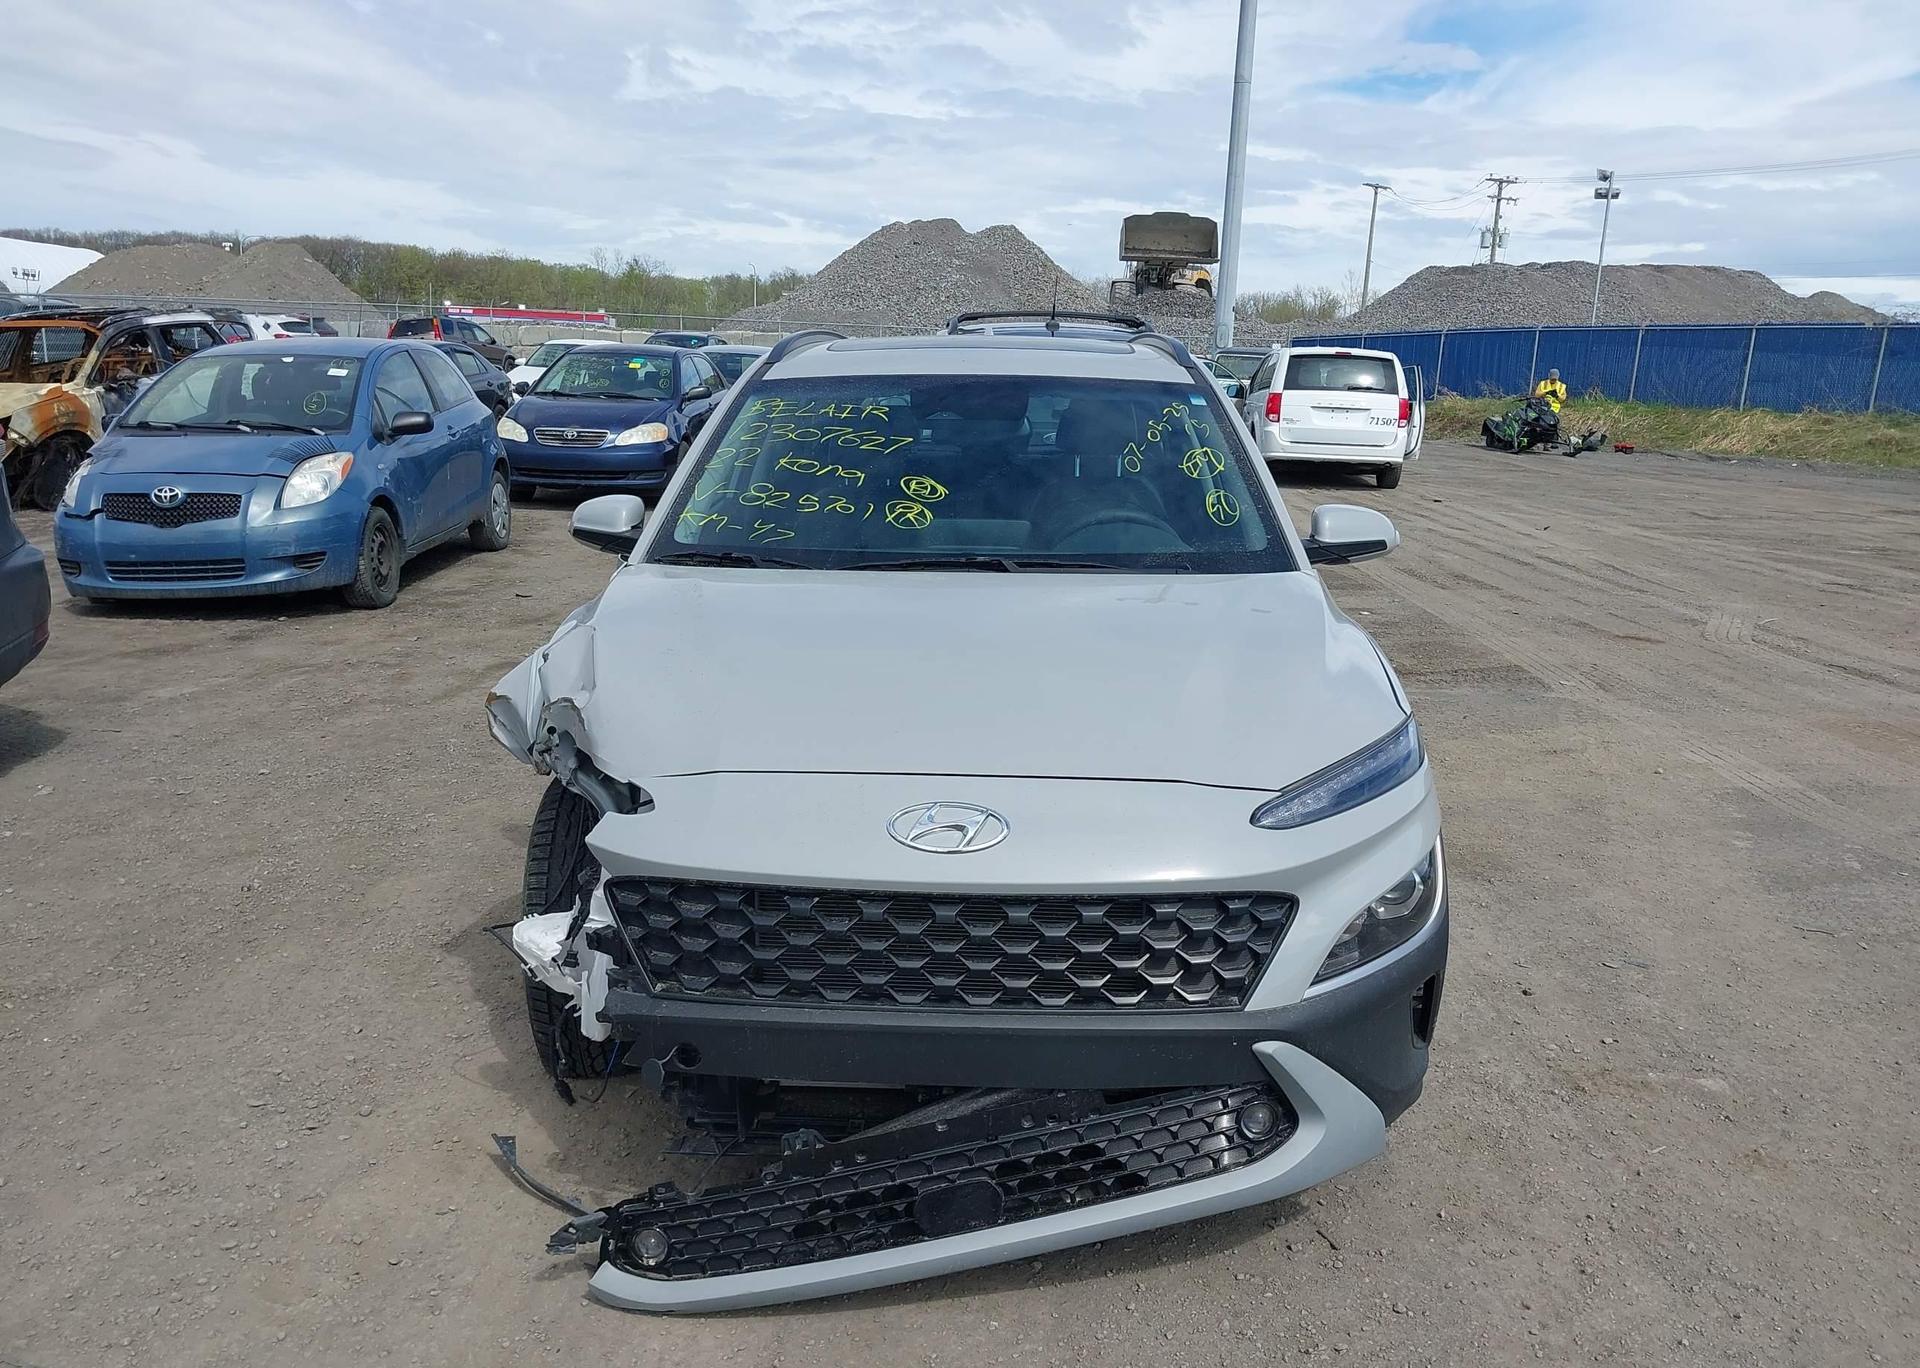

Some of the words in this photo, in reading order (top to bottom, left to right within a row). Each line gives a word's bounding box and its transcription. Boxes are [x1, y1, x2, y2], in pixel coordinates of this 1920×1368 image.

[740, 398, 890, 422] BELAIR
[1369, 416, 1398, 427] 71507
[704, 447, 761, 468] 22
